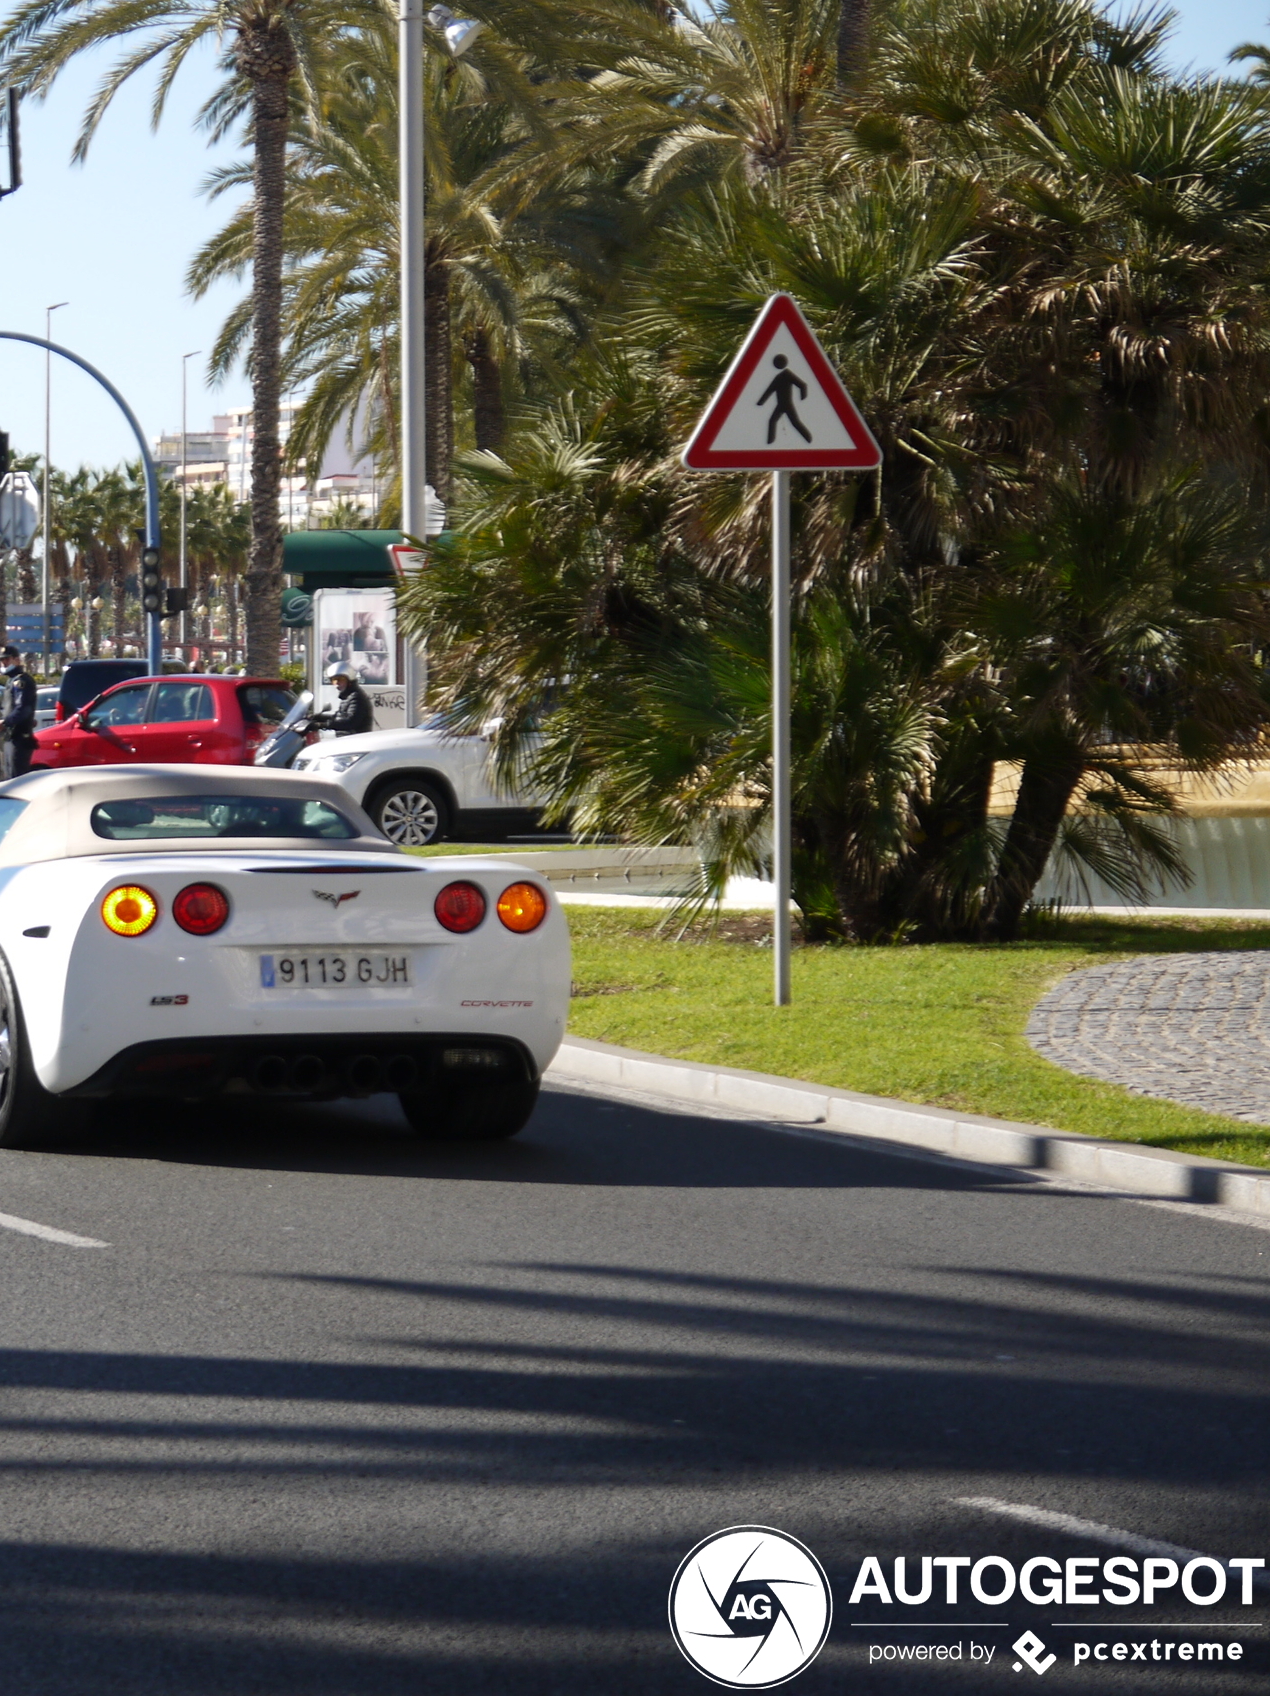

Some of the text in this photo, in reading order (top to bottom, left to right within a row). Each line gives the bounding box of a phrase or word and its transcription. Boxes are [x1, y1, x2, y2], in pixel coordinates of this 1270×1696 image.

[280, 957, 408, 983] 9113 GJH
[150, 994, 189, 1006] LS3
